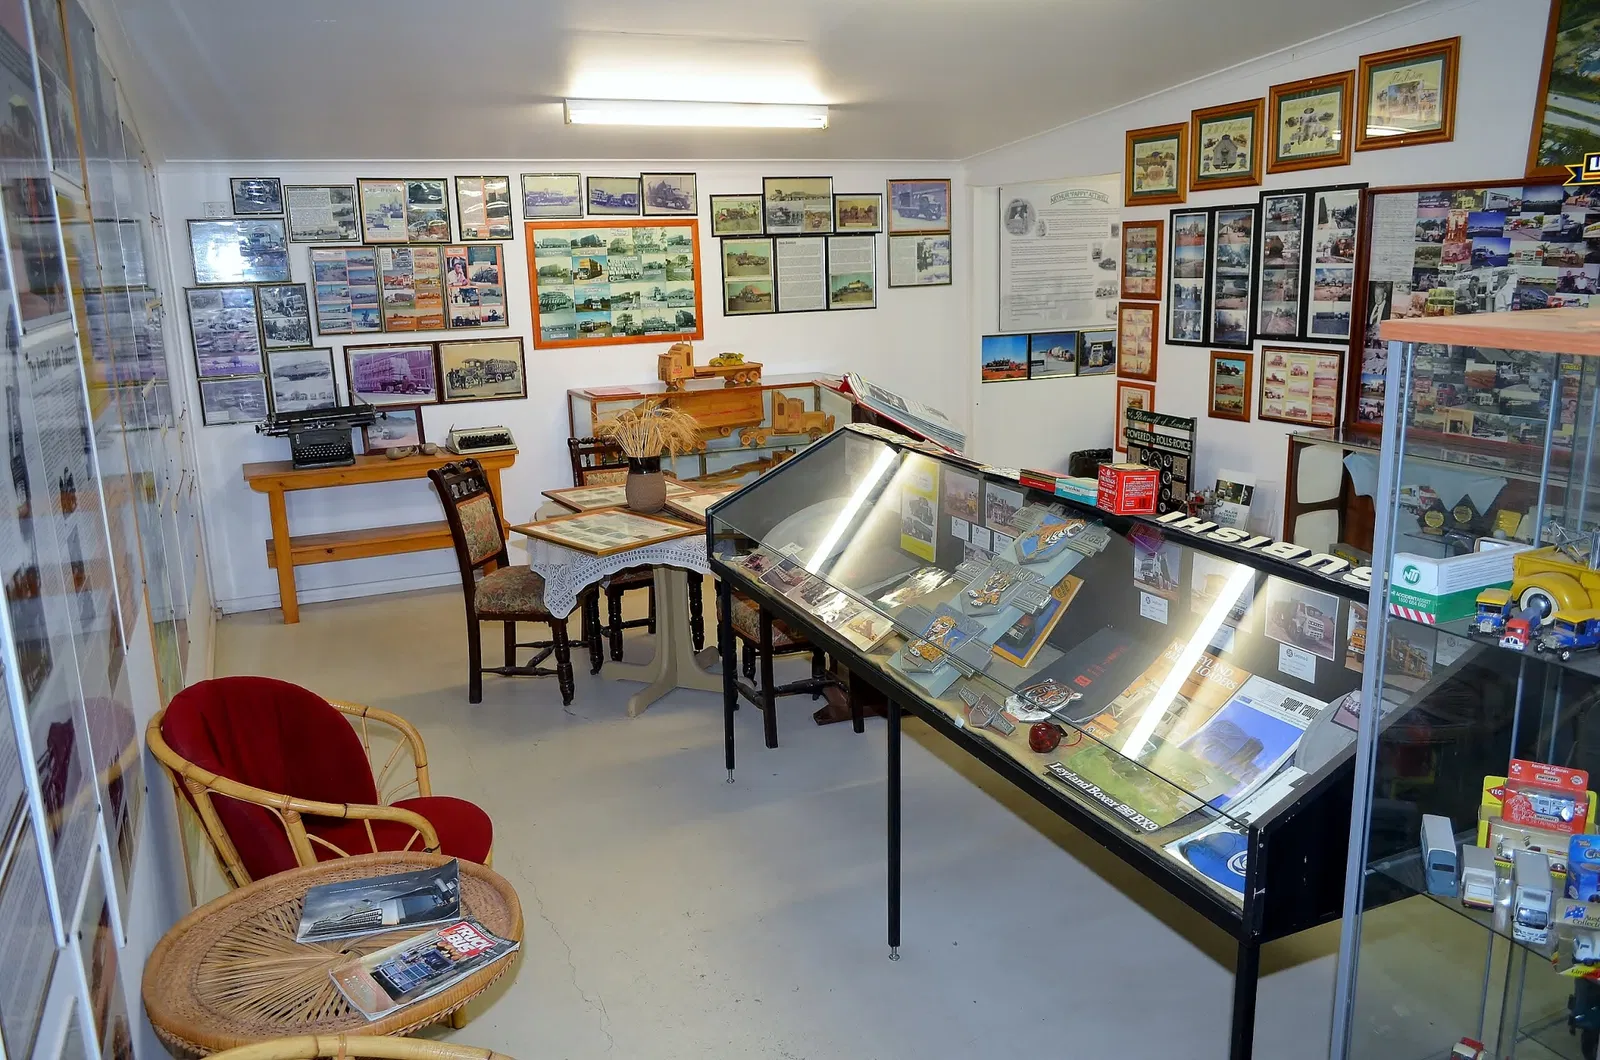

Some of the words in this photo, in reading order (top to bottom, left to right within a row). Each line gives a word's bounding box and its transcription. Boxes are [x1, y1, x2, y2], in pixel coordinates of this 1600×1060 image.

[1126, 428, 1151, 442] POWERED
[1156, 434, 1191, 451] ROLLS-ROYCE
[1080, 532, 1105, 547] TIGER
[1403, 568, 1420, 582] NTI
[1195, 665, 1238, 690] LOADERS
[1279, 696, 1302, 713] super
[1049, 762, 1091, 790] Leyland
[1087, 786, 1119, 807] Boxer
[1130, 813, 1159, 831] BX9
[445, 933, 477, 953] BUS
[455, 924, 494, 951] TRUCK
